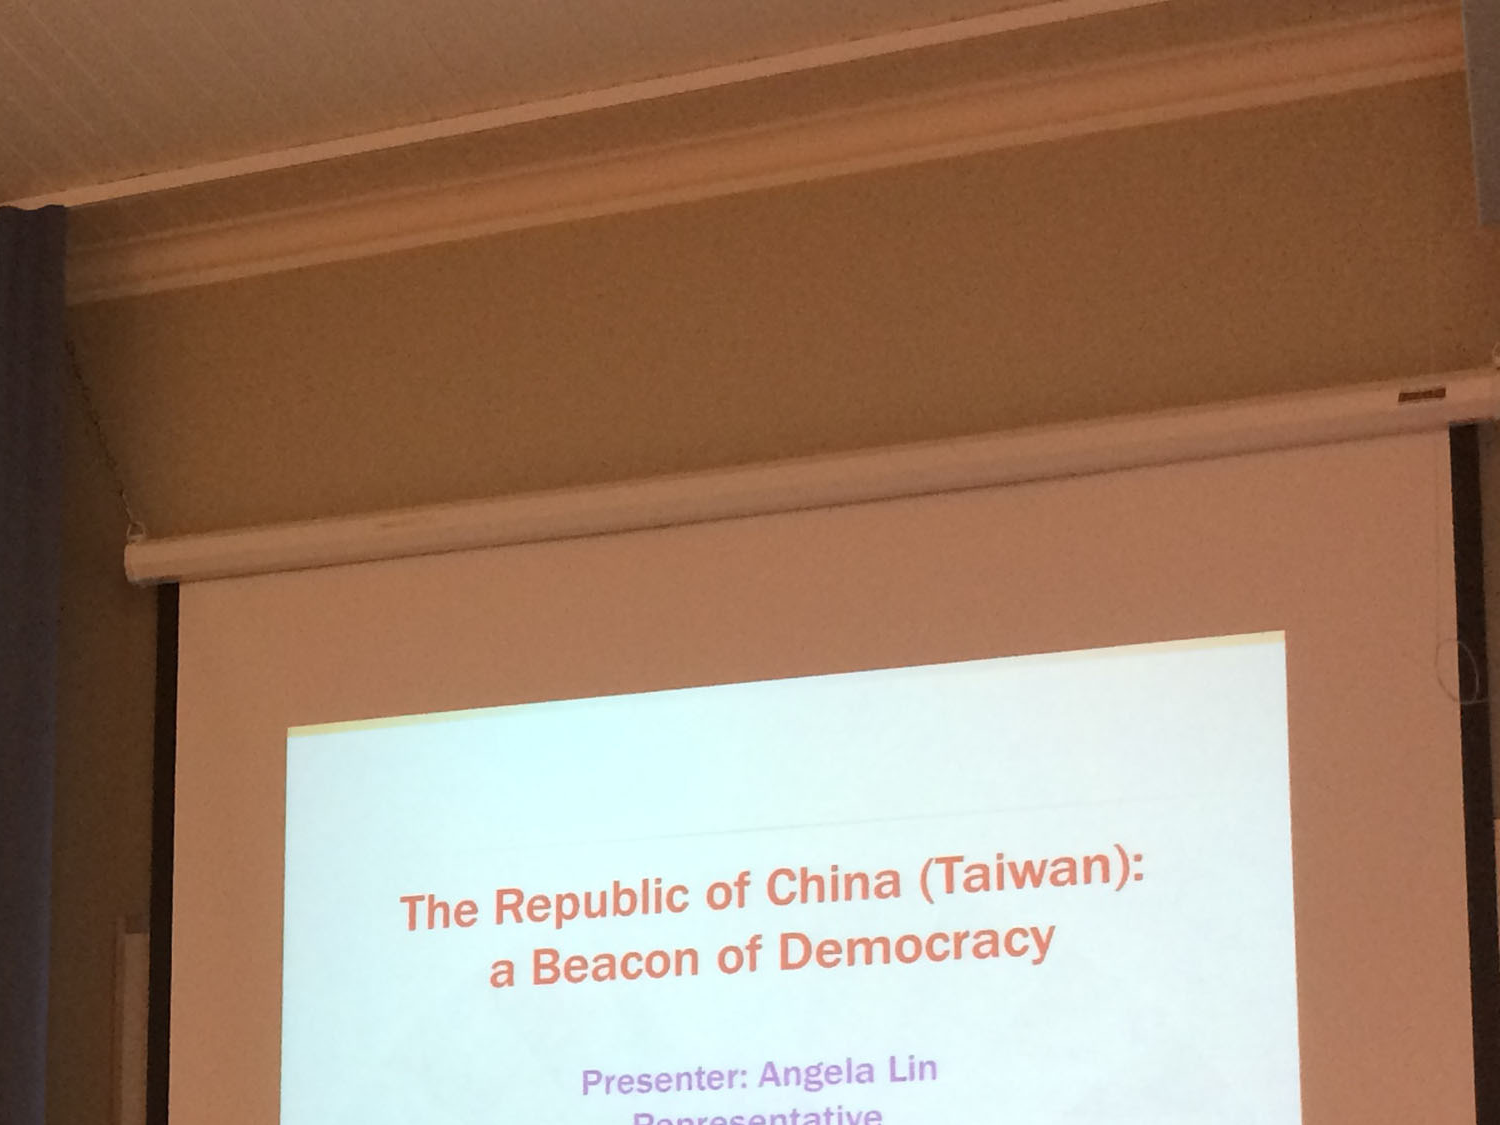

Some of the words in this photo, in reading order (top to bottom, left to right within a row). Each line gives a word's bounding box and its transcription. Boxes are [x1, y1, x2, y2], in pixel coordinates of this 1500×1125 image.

[399, 894, 480, 932] The
[495, 877, 690, 931] Republic
[706, 870, 752, 911] of
[766, 864, 902, 907] China
[920, 843, 1145, 905] (Taiwan):
[490, 960, 516, 990] a
[532, 948, 700, 986] Beacon
[717, 934, 764, 976] of
[780, 925, 1057, 971] Democracy
[582, 1066, 748, 1097] Presenter:
[758, 1057, 875, 1093] Angela
[889, 1055, 938, 1083] Lin
